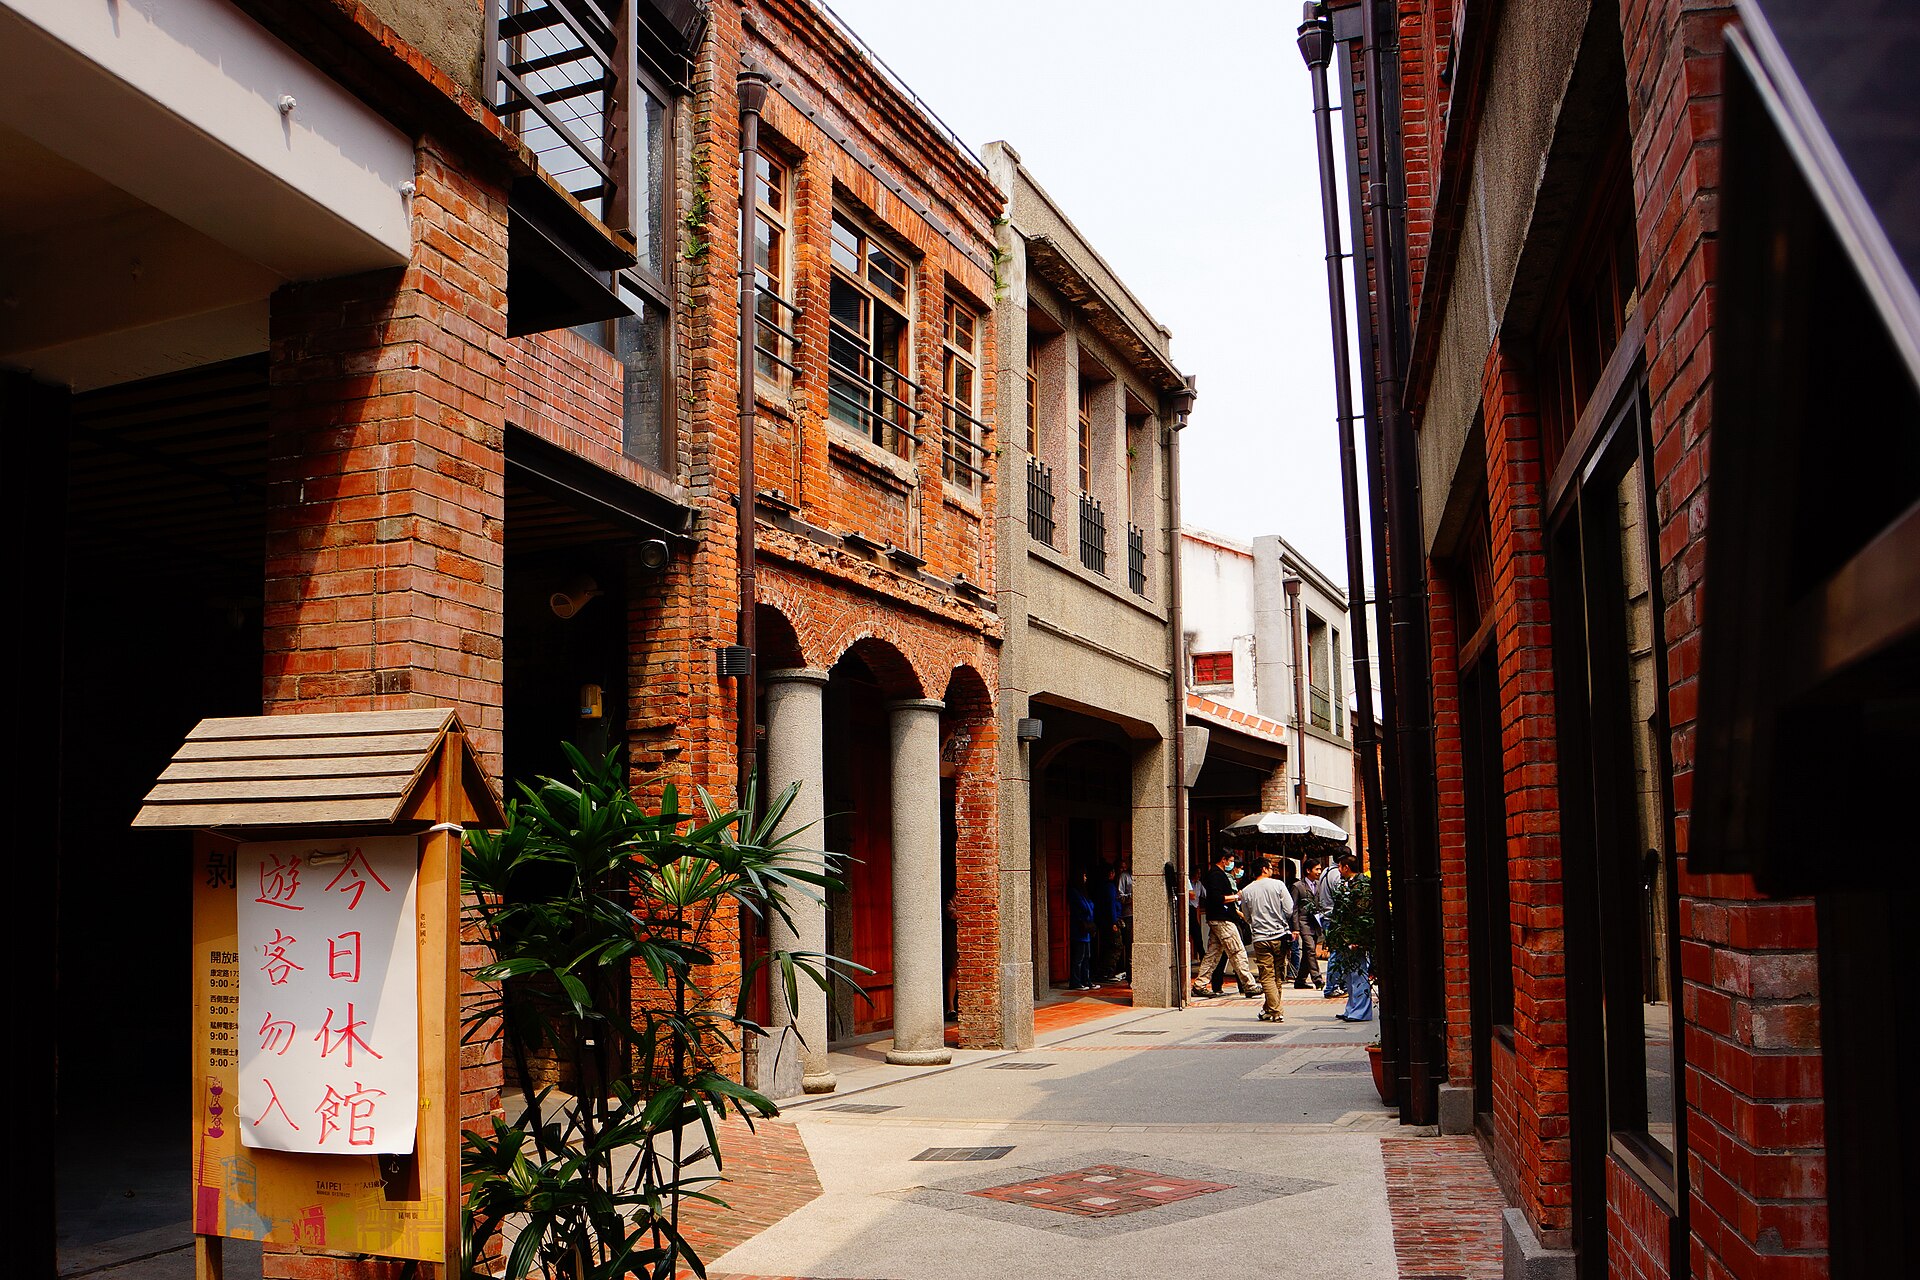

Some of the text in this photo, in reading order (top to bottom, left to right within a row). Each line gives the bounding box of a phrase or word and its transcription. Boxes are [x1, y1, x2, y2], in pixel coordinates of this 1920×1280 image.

[210, 979, 228, 988] 9:00
[253, 853, 304, 1131] 遊客勿入
[313, 847, 391, 1146] 今日休館
[210, 1006, 228, 1015] 9:00
[210, 1031, 228, 1040] 9:00
[210, 1058, 228, 1067] 9:00
[316, 1180, 342, 1191] TAIPEI
